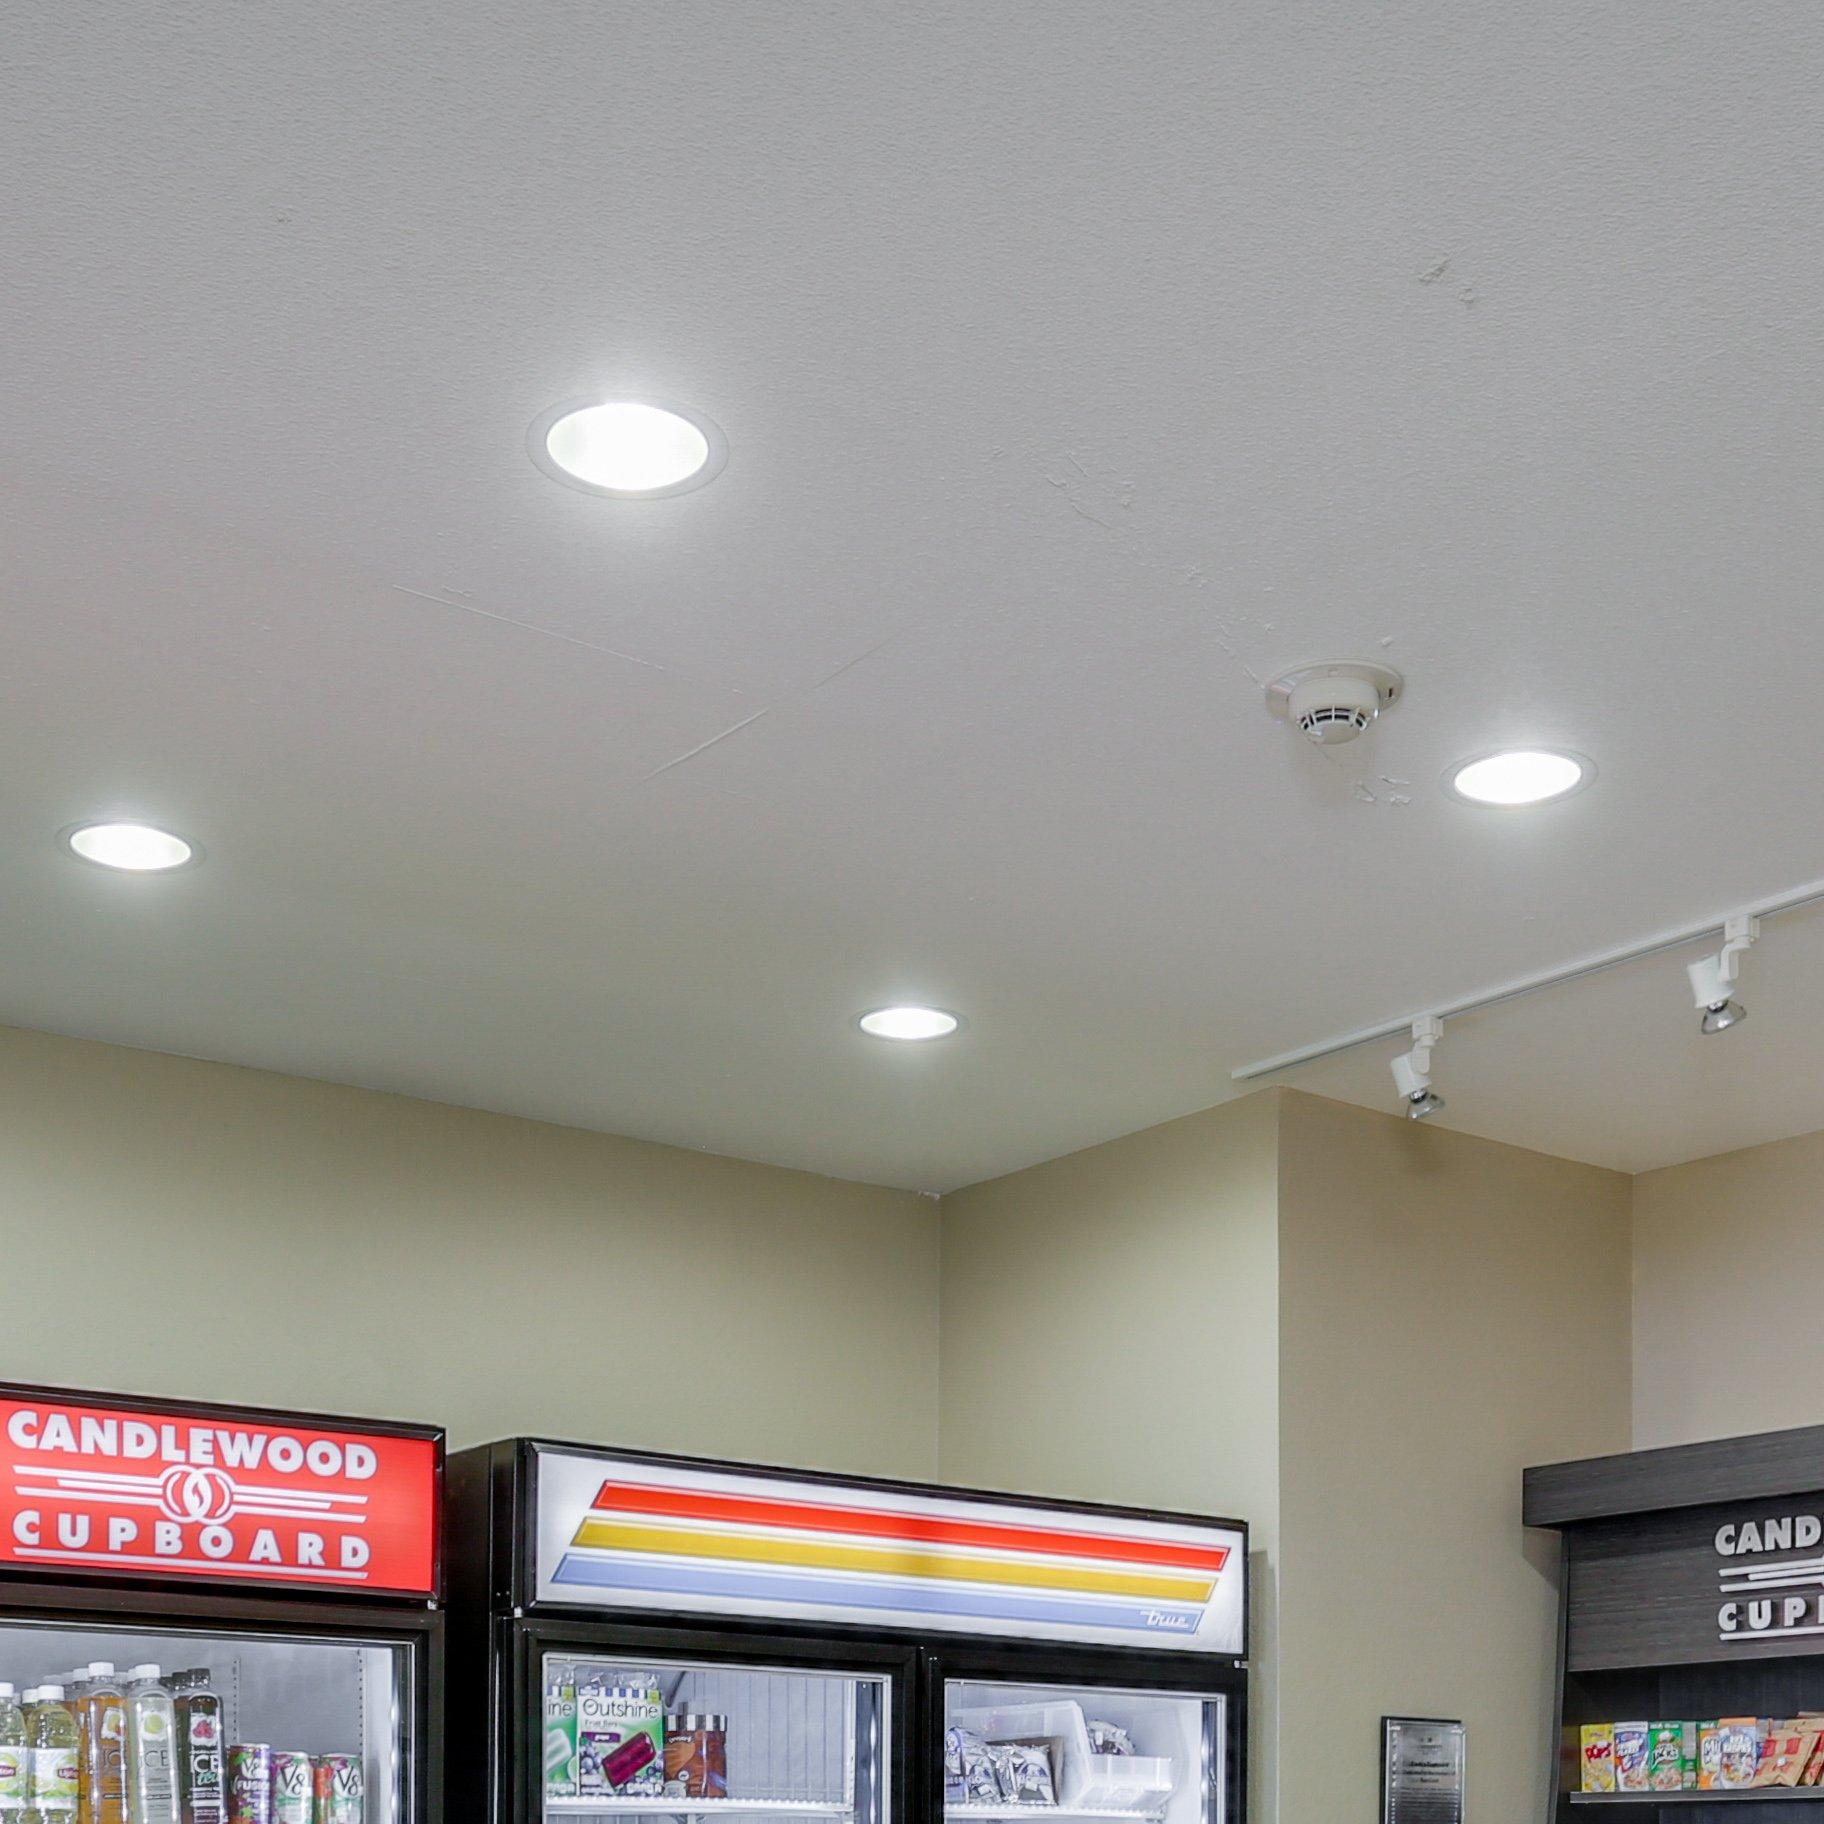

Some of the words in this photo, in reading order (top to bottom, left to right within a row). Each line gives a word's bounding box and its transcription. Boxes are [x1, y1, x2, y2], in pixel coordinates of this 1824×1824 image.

[7, 1408, 377, 1481] CANDLEWOOD
[12, 1507, 371, 1569] CUPBOARD
[582, 1697, 658, 1720] Outshine
[281, 1764, 305, 1796] V8
[336, 1765, 359, 1797] V8
